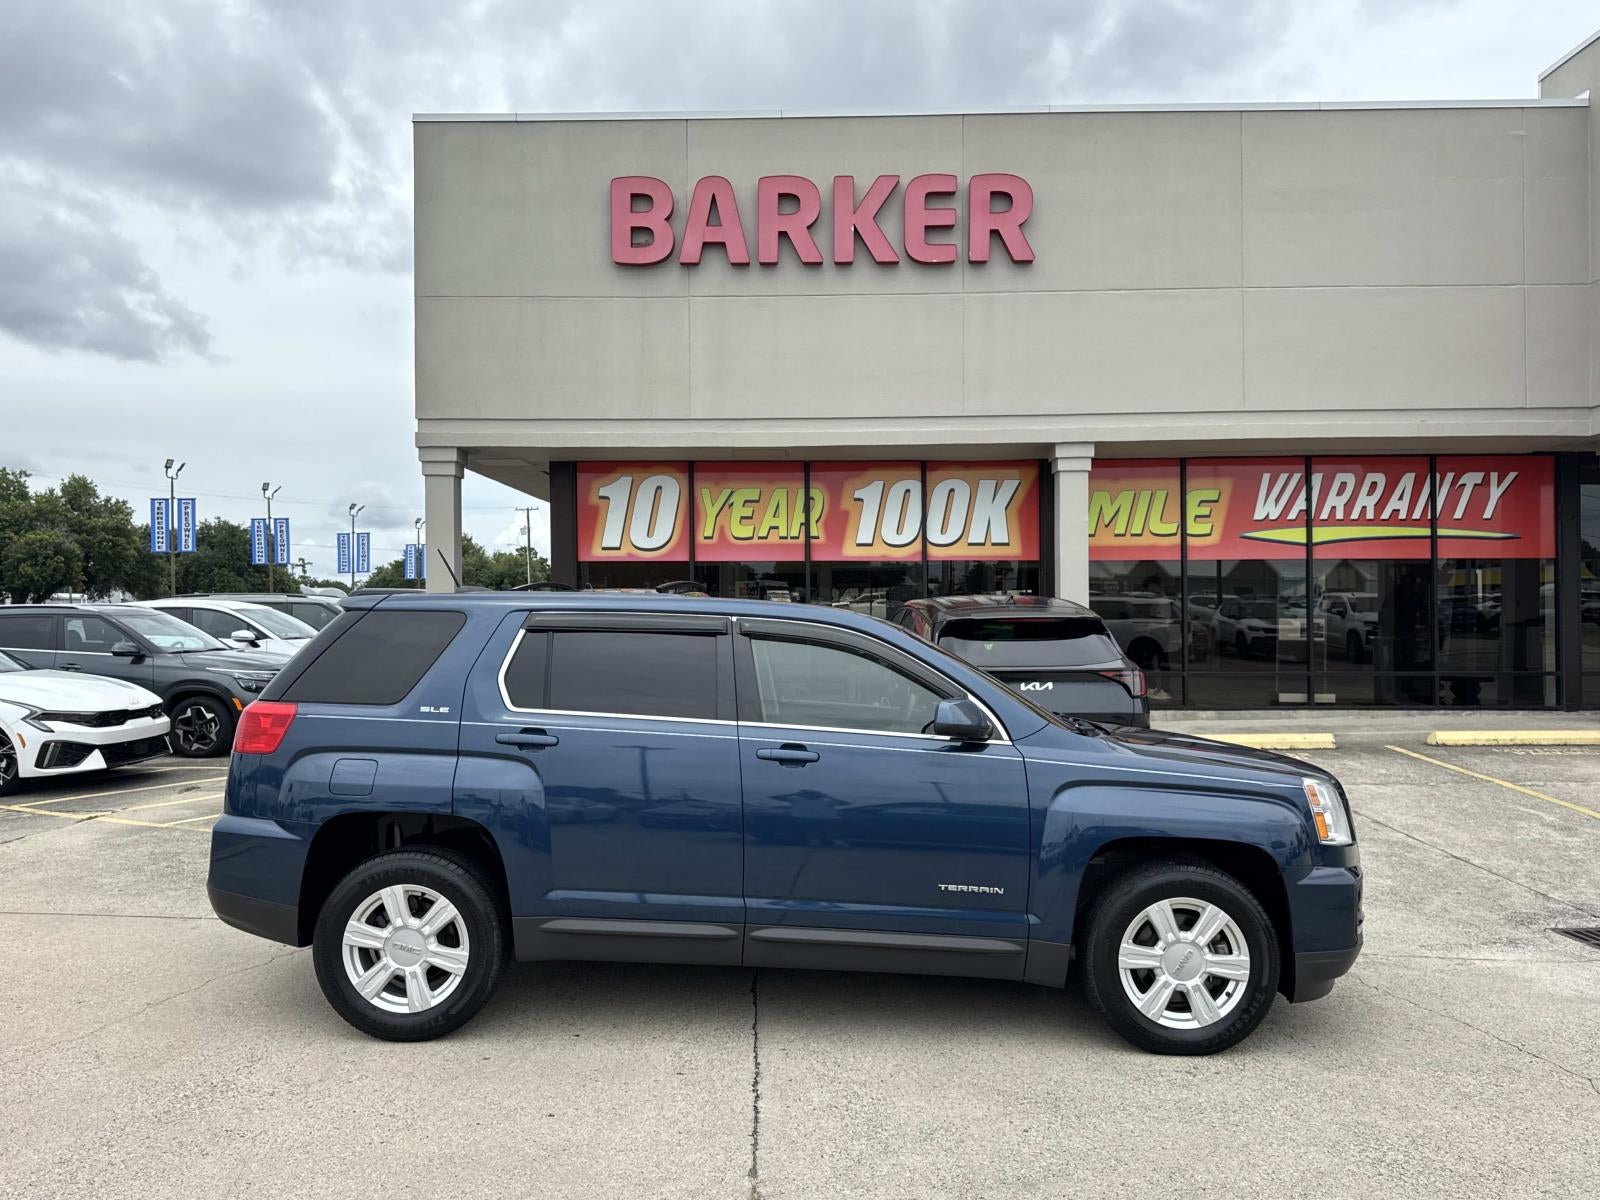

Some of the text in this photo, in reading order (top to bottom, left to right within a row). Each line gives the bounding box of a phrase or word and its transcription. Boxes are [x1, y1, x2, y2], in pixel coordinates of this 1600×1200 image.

[610, 173, 1036, 266] BARKER
[183, 506, 191, 550] PREOWNED
[598, 471, 1520, 552] 10 YEAR 100K MILE WARRANTY
[1020, 681, 1054, 691] KIA
[938, 884, 1005, 895] TERRAIN
